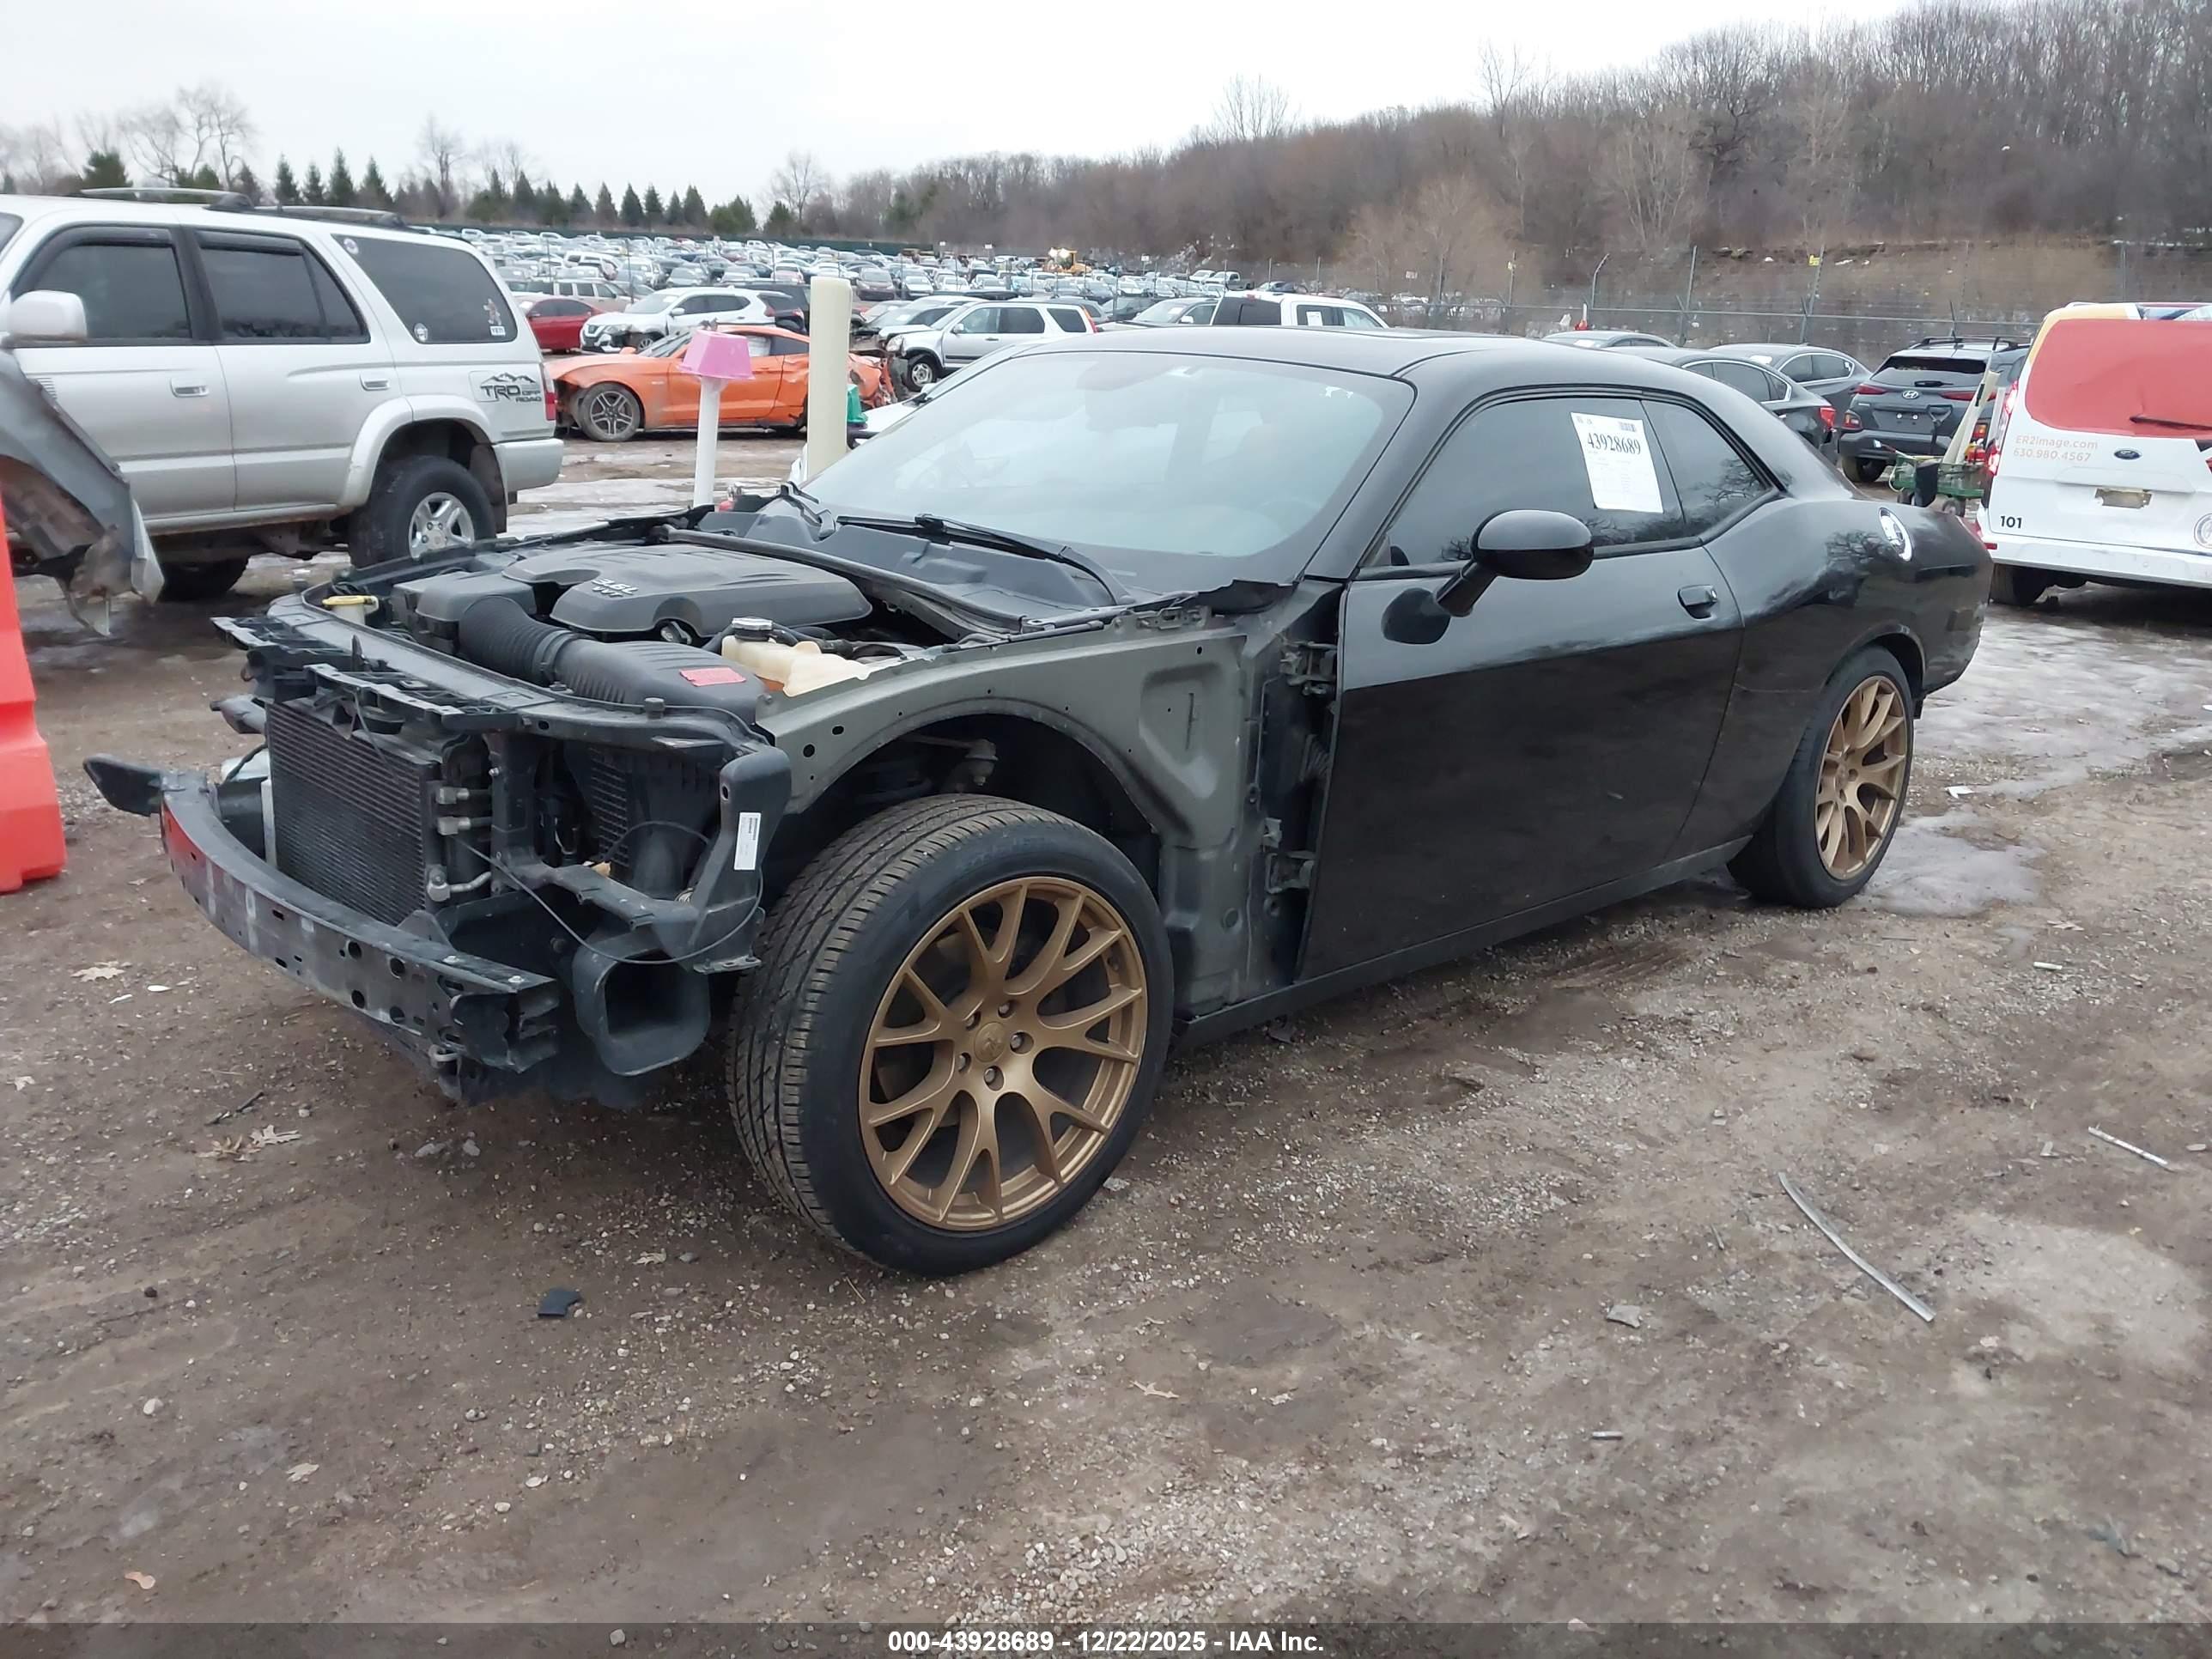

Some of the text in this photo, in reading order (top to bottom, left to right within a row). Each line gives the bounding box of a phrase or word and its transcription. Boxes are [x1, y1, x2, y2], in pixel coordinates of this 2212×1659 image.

[481, 385, 521, 400] TRD
[1587, 432, 1641, 455] 43928689
[2000, 515, 2023, 529] 101
[591, 578, 639, 596] 3.6L
